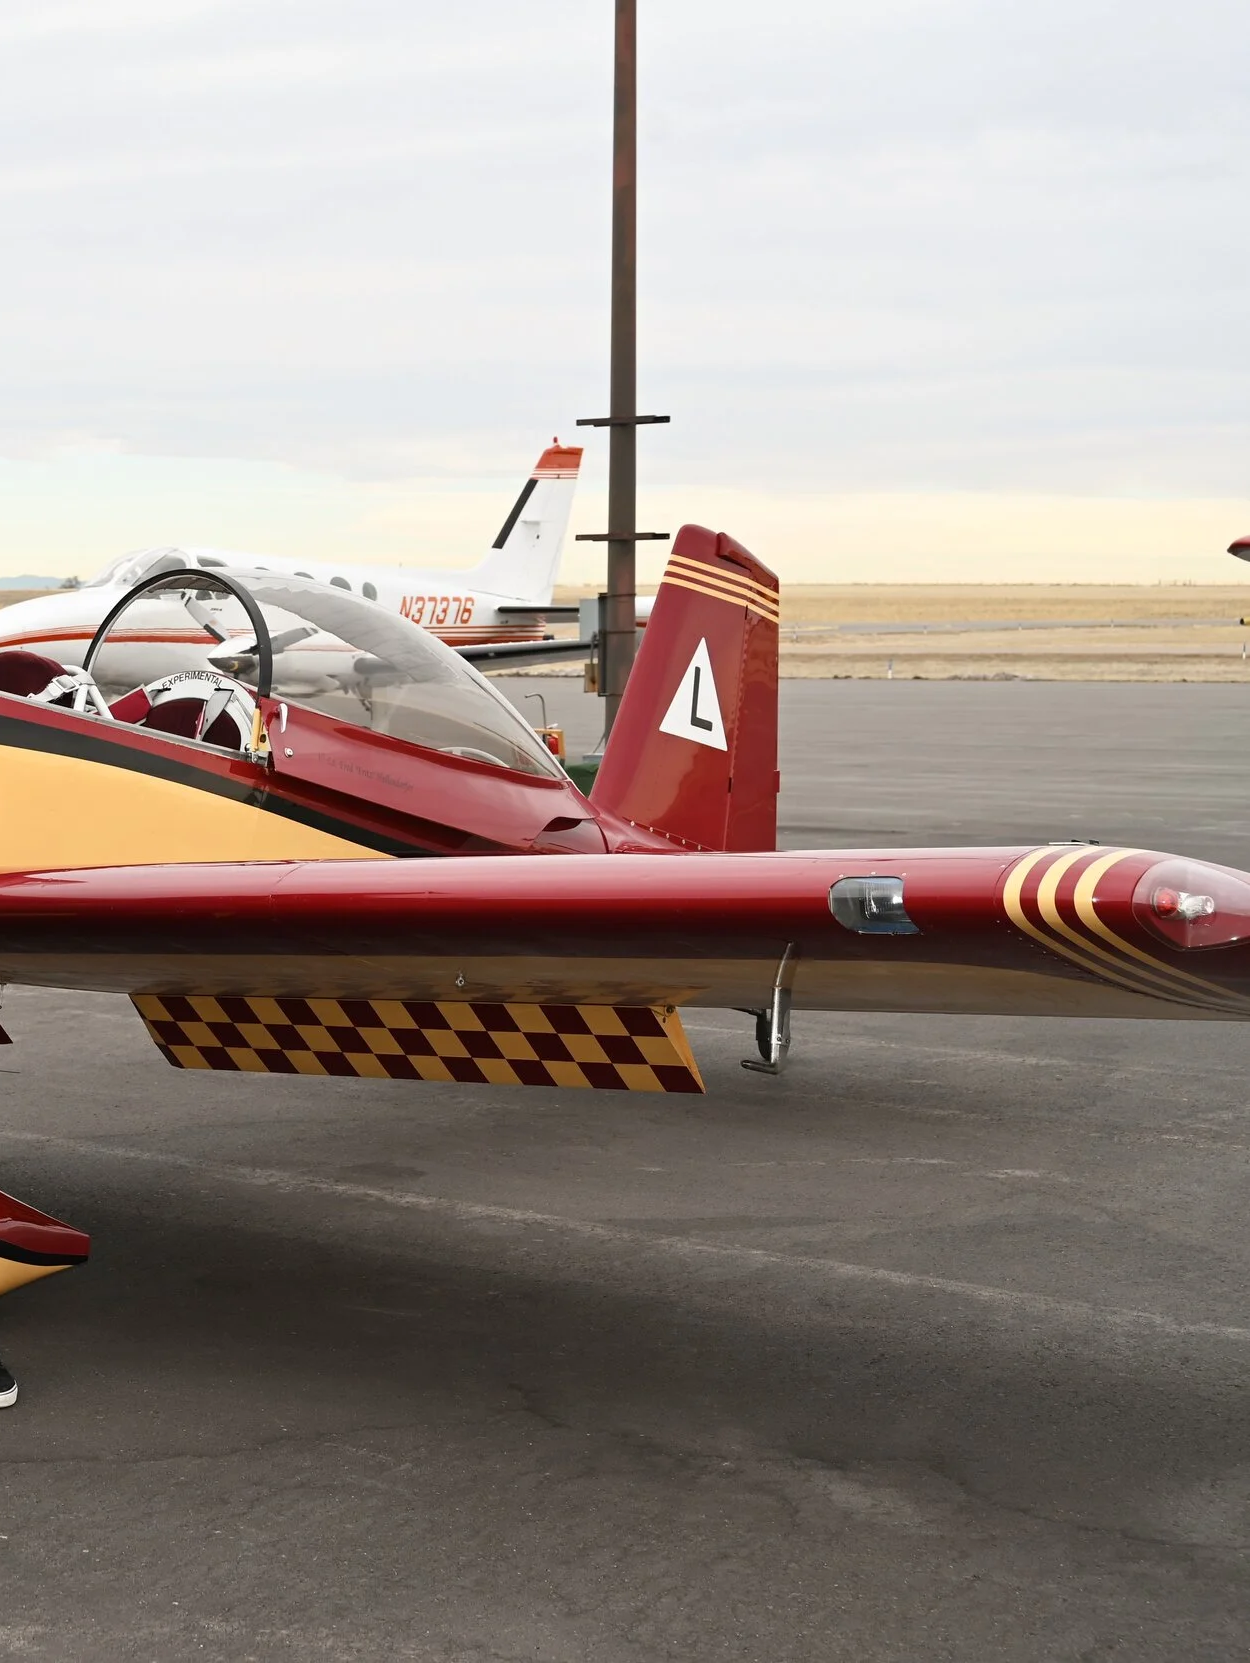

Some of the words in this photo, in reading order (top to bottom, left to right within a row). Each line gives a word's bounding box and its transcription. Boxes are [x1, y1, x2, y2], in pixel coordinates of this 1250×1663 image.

[400, 596, 475, 625] N37376
[161, 671, 223, 689] EXPERIMENTAL
[691, 666, 713, 732] L
